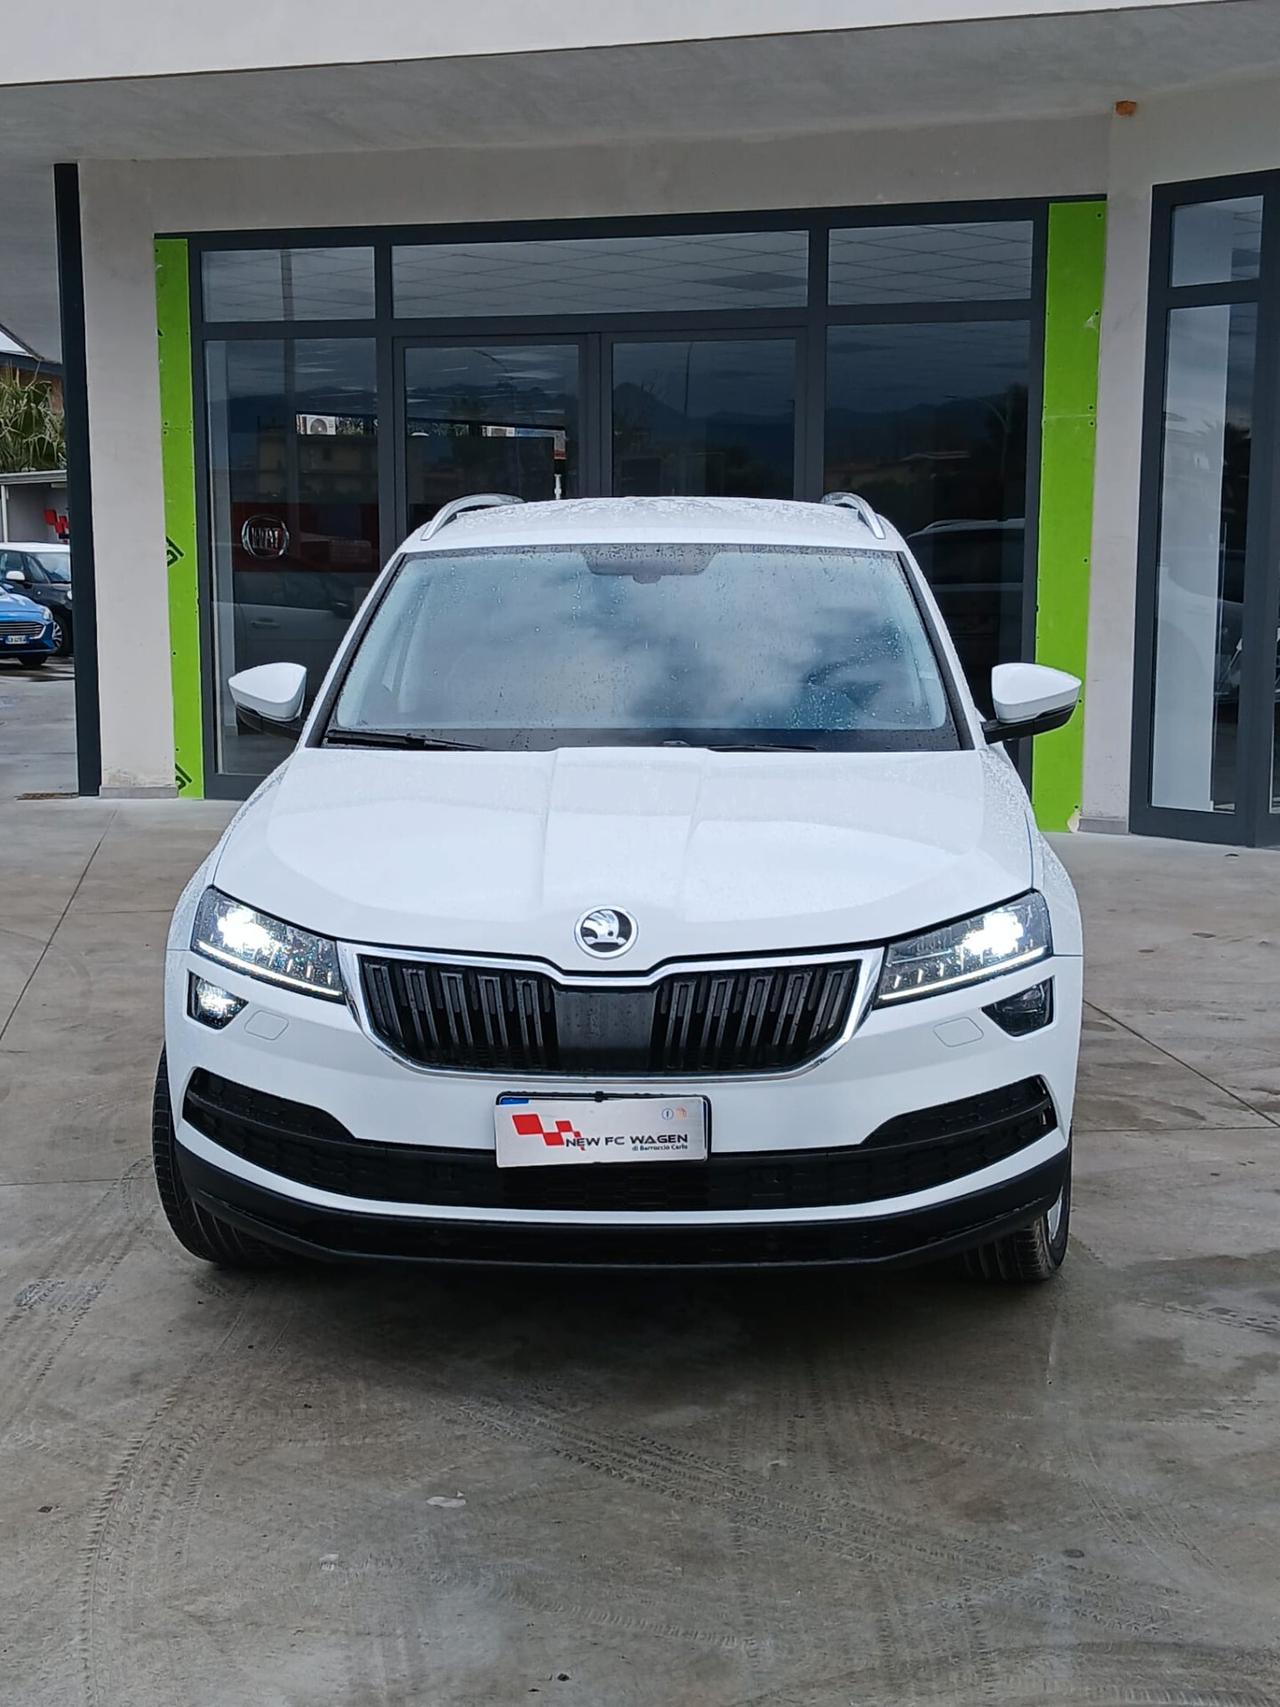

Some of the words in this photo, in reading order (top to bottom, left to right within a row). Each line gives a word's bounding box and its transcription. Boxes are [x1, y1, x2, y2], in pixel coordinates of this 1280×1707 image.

[566, 1137, 600, 1147] NEW
[605, 1136, 625, 1145] FC
[630, 1133, 688, 1145] WAGEN
